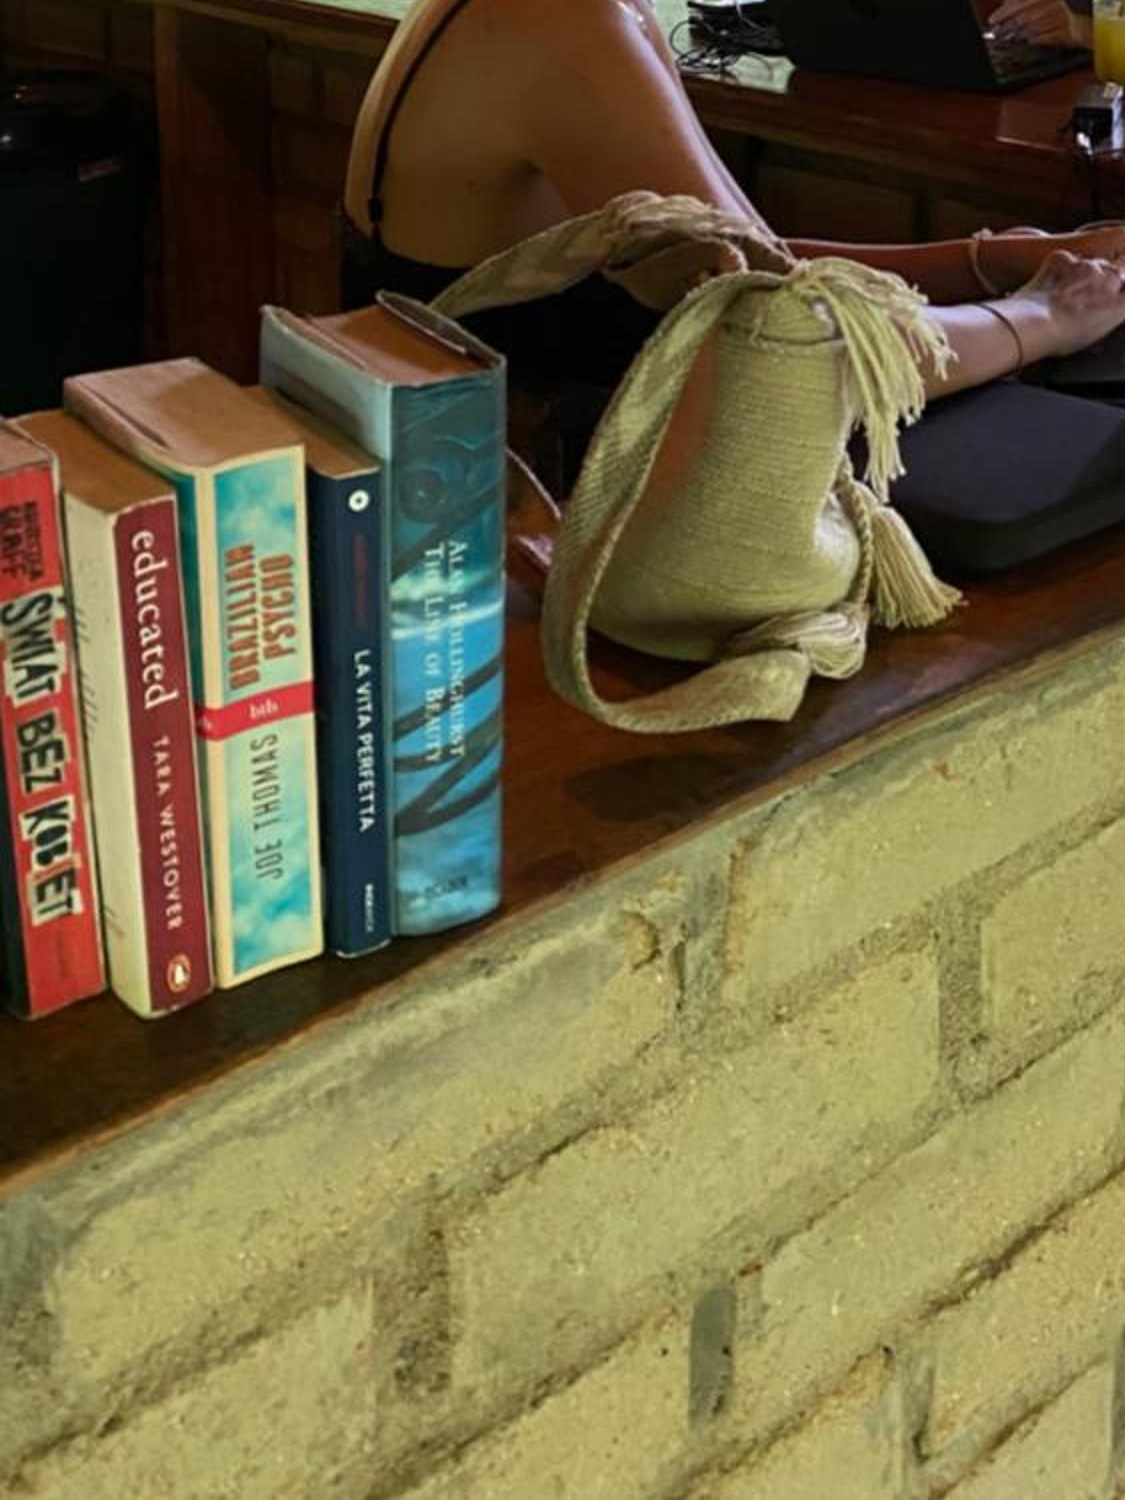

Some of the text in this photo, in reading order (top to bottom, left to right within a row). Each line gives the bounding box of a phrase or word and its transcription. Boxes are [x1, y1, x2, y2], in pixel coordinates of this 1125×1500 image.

[131, 530, 179, 709] educated
[223, 543, 260, 690] BRAZILIAN
[259, 553, 297, 661] PSYCHO
[353, 649, 371, 679] LA
[355, 681, 373, 730] VITA
[18, 712, 65, 794] BEZ
[250, 733, 285, 881] JOE THOMAS
[357, 732, 376, 833] PERFETTA
[153, 735, 185, 931] TARA WESTOVER
